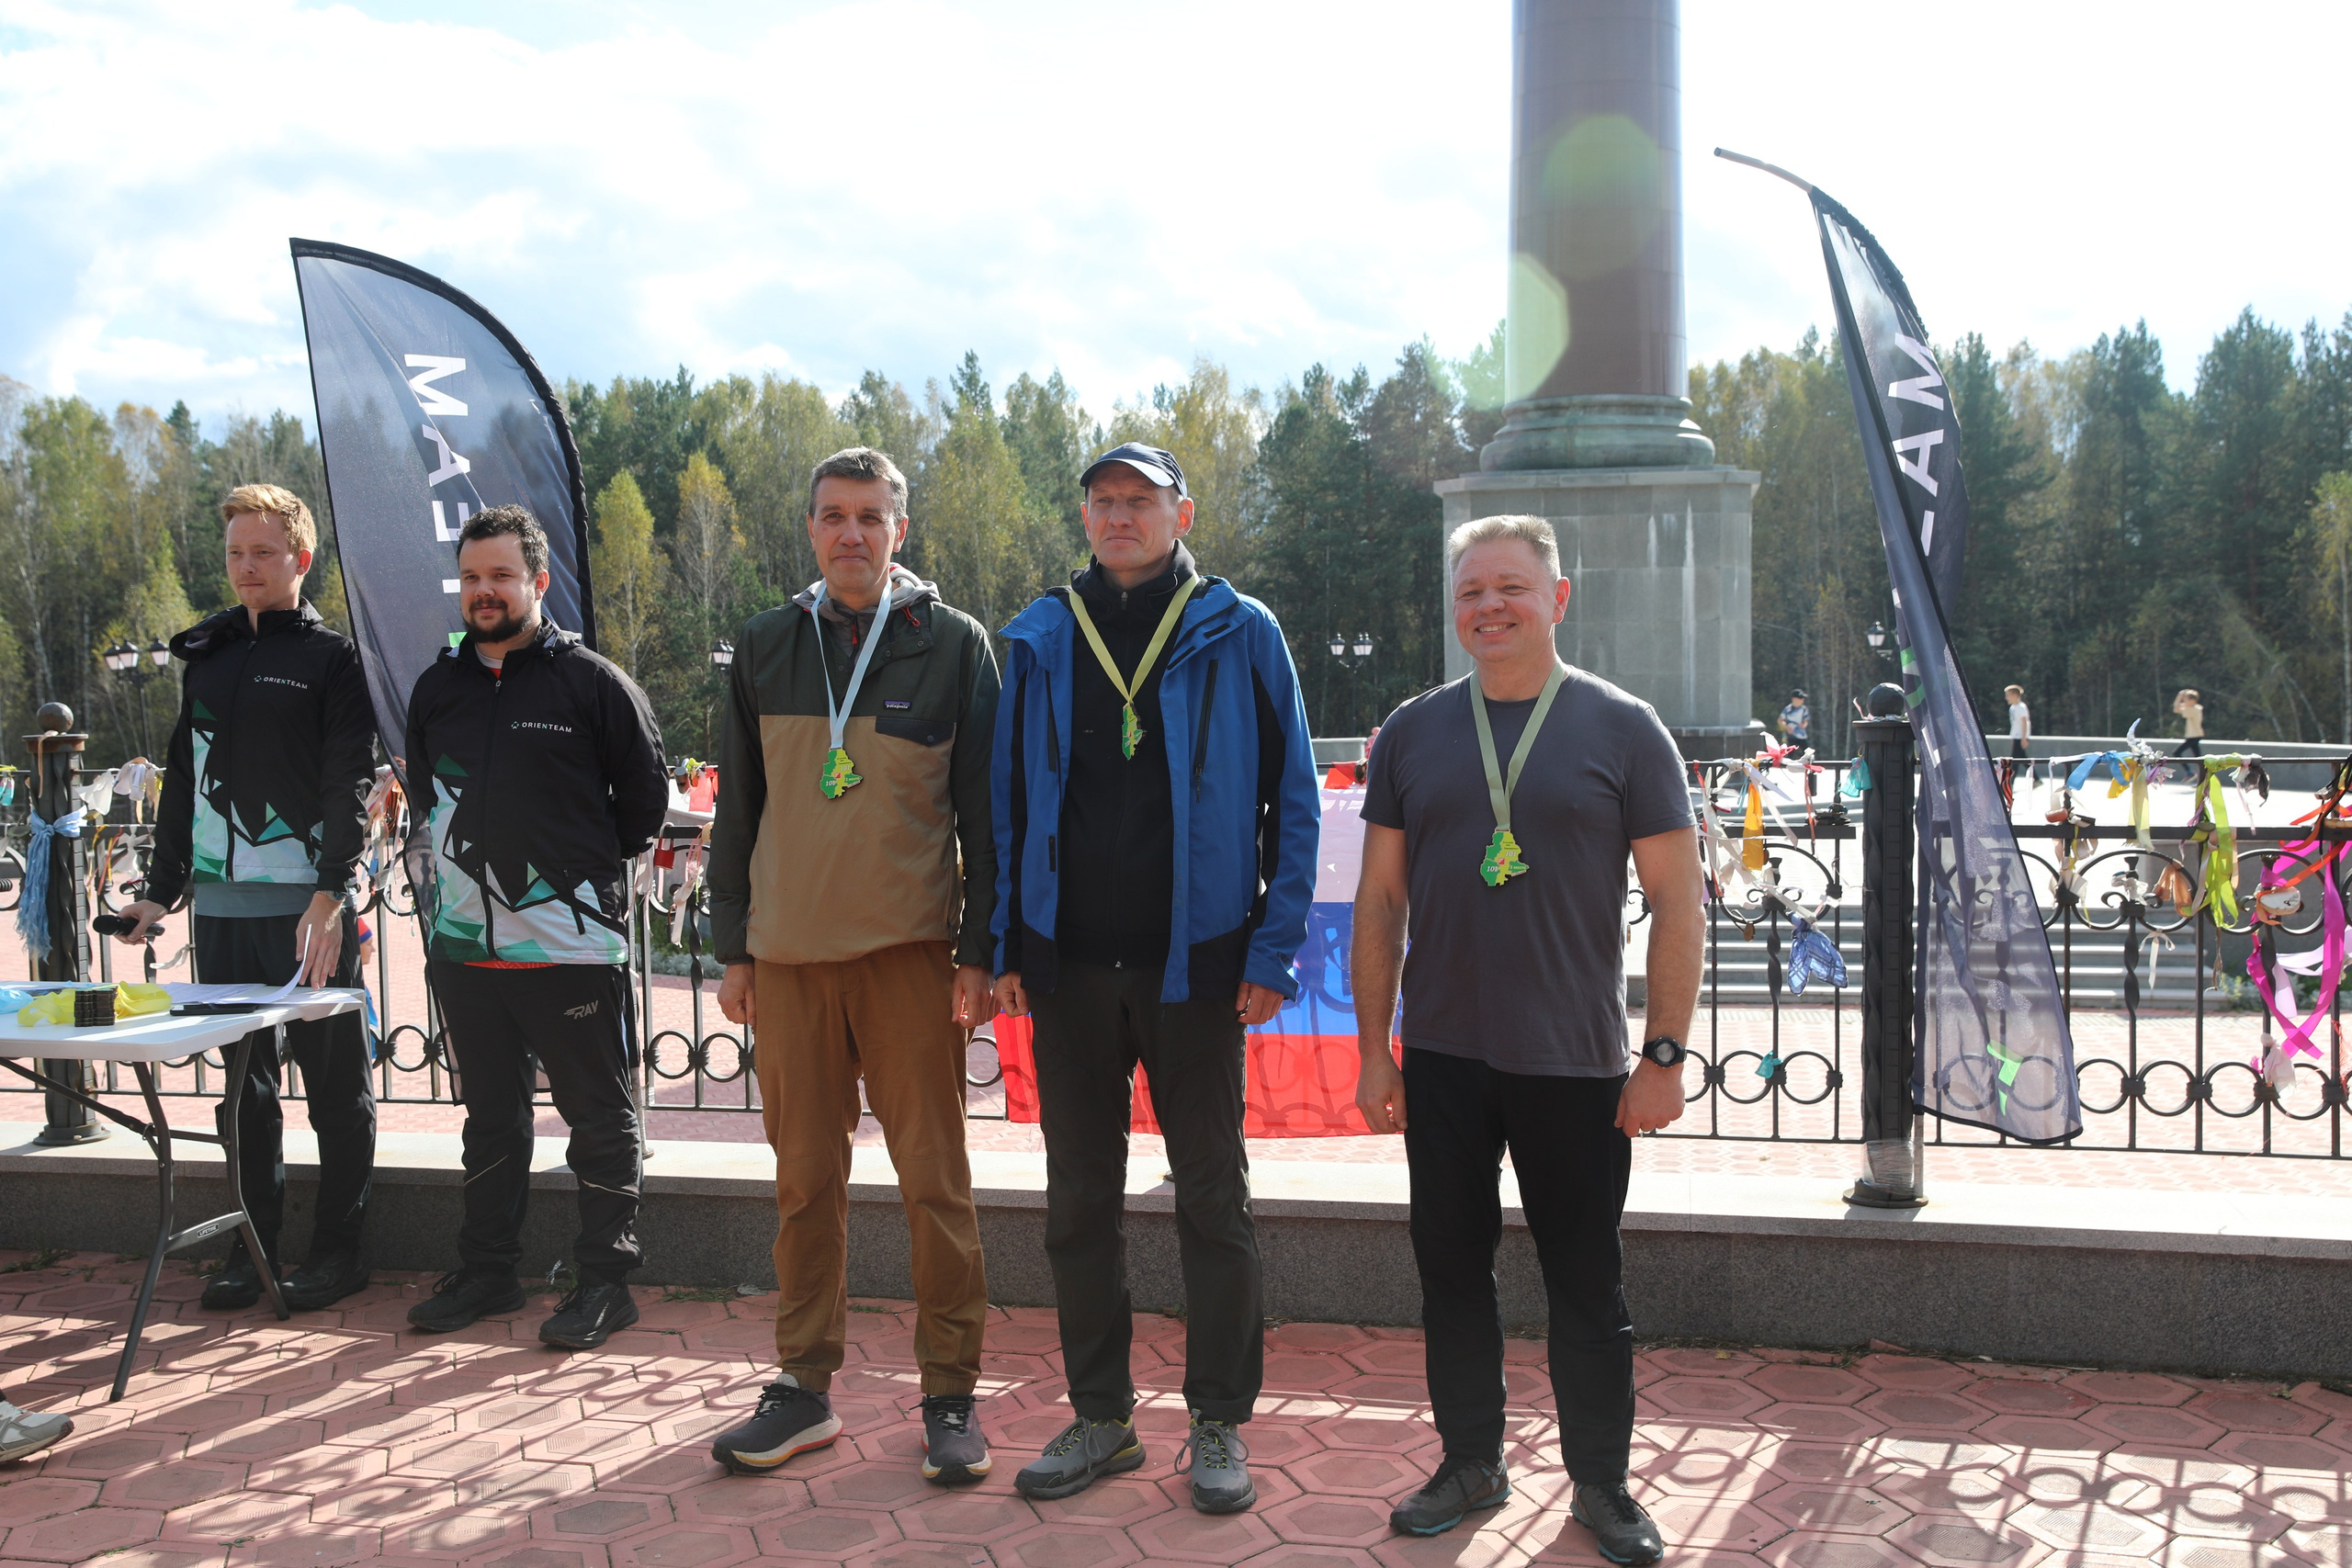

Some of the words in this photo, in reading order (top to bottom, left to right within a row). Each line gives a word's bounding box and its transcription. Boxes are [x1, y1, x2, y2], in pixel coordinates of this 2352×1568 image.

[263, 676, 308, 690] ORIENTEAM
[521, 721, 572, 733] ORIENTEAM
[564, 999, 599, 1020] RAY
